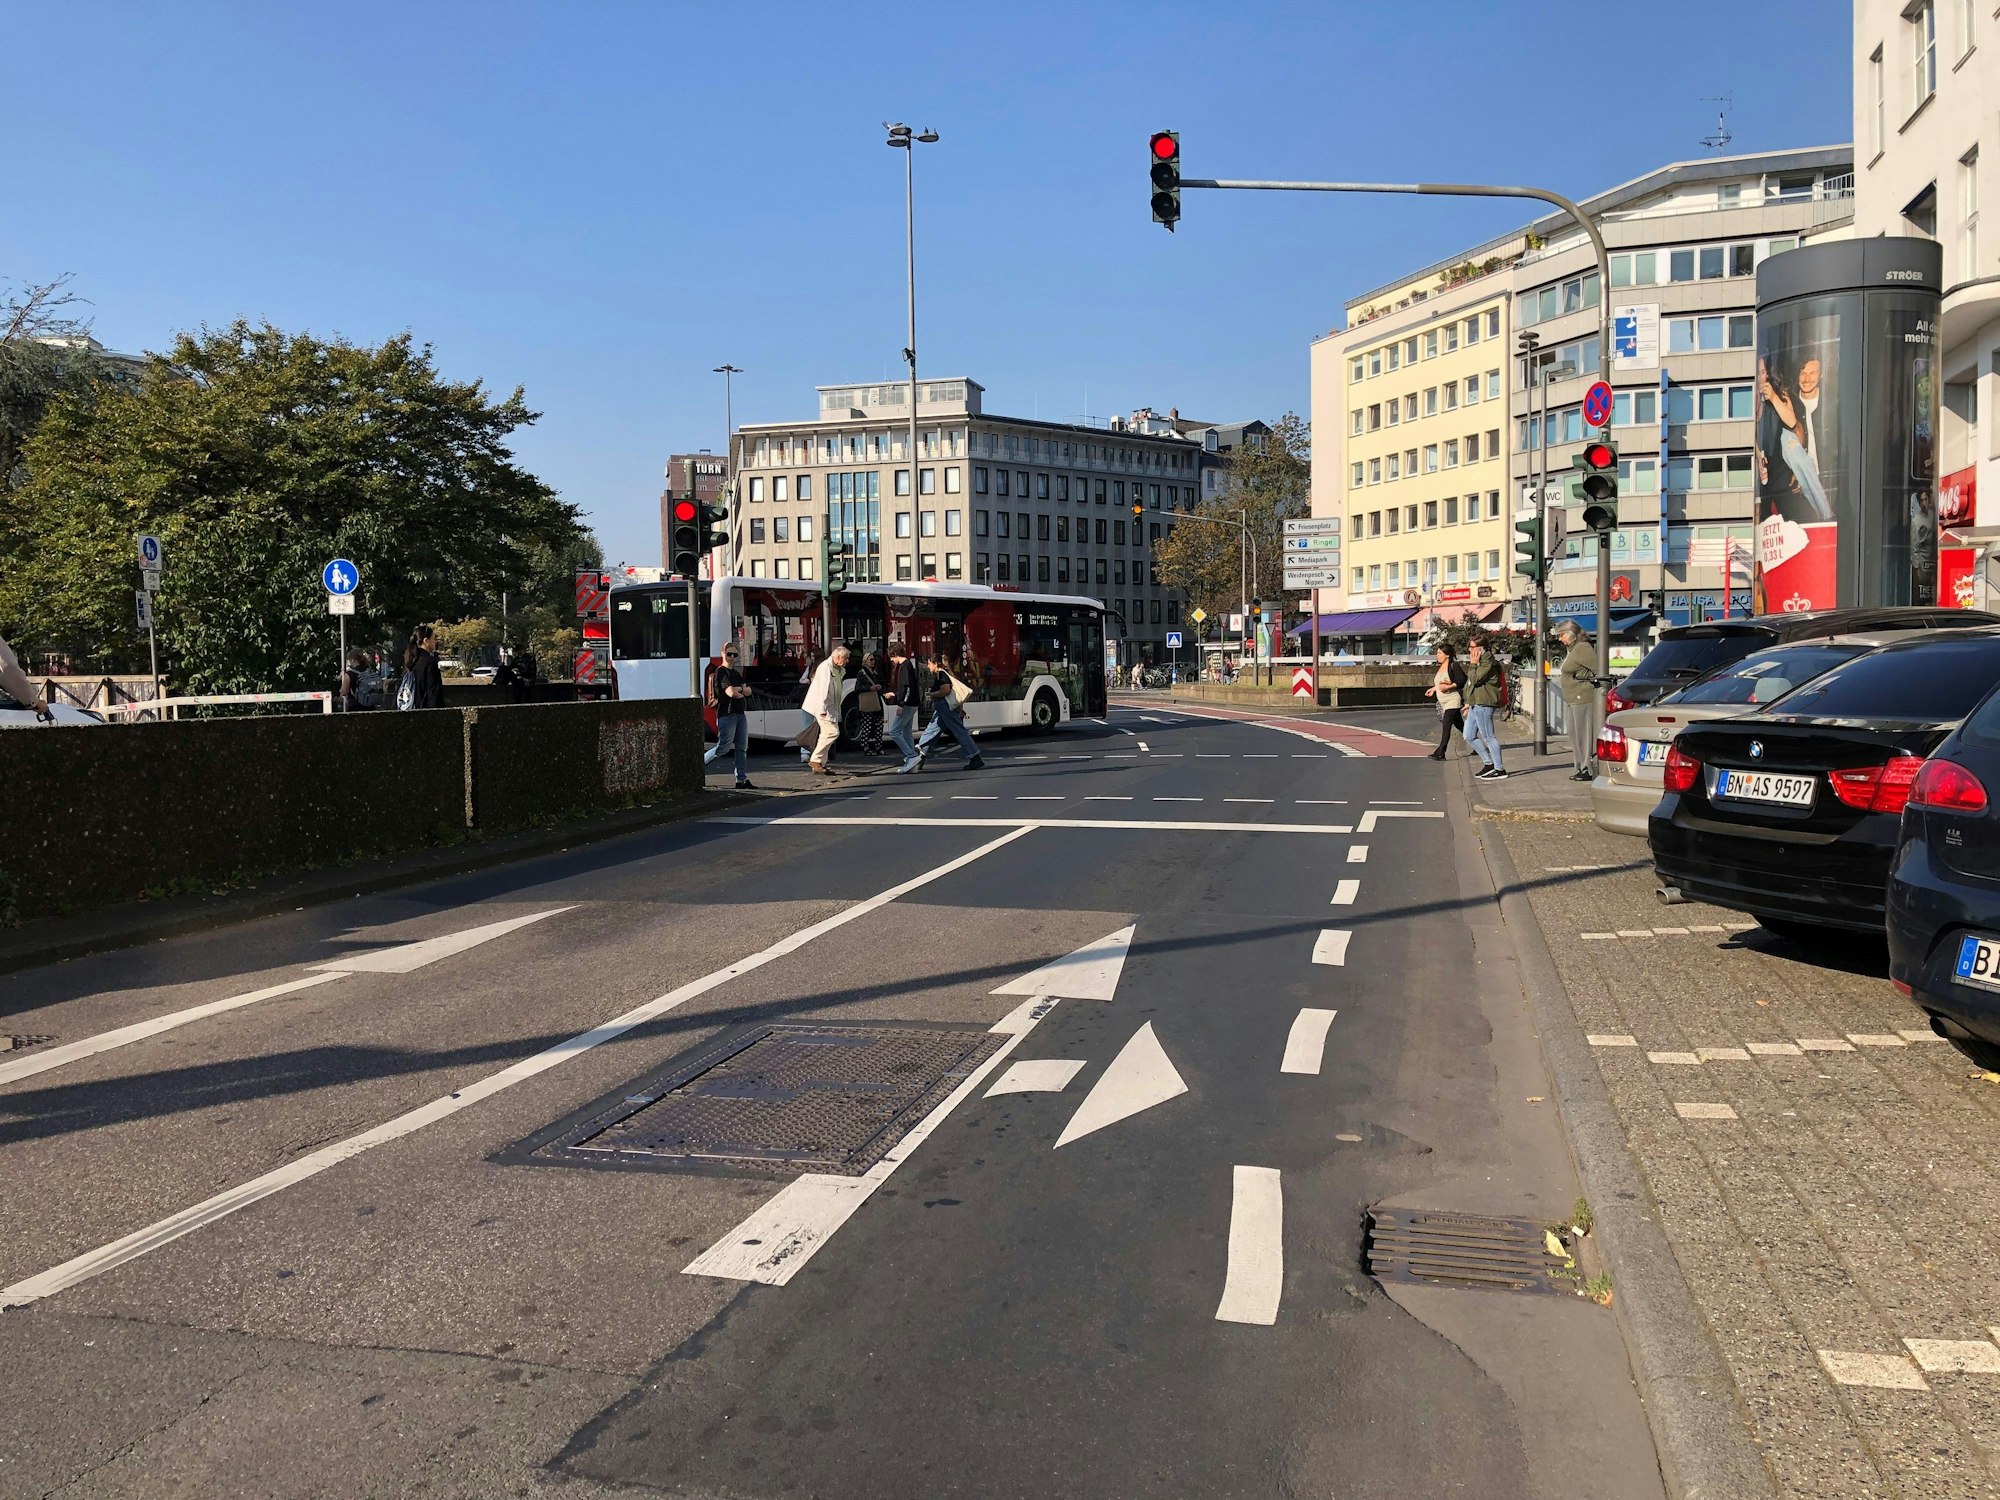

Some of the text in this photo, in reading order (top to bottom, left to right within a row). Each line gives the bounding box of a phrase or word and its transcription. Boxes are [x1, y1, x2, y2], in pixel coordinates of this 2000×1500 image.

[1885, 270, 1923, 281] STRÖER
[1916, 320, 1929, 332] All
[1904, 333, 1929, 344] mehr
[683, 462, 722, 474] TURN
[1545, 491, 1561, 501] WC
[1763, 522, 1780, 537] JETZT
[1313, 539, 1333, 547] Ringe
[1762, 535, 1784, 550] NEU IN
[1298, 556, 1328, 564] Mediapark
[1763, 549, 1778, 563] 0,33
[1287, 571, 1325, 579] Weidenpesch
[1564, 600, 1598, 612] APOTHEK
[1646, 745, 1654, 759] K
[1727, 774, 1745, 794] BN
[1752, 776, 1771, 796] AS
[1774, 778, 1812, 800] 9597
